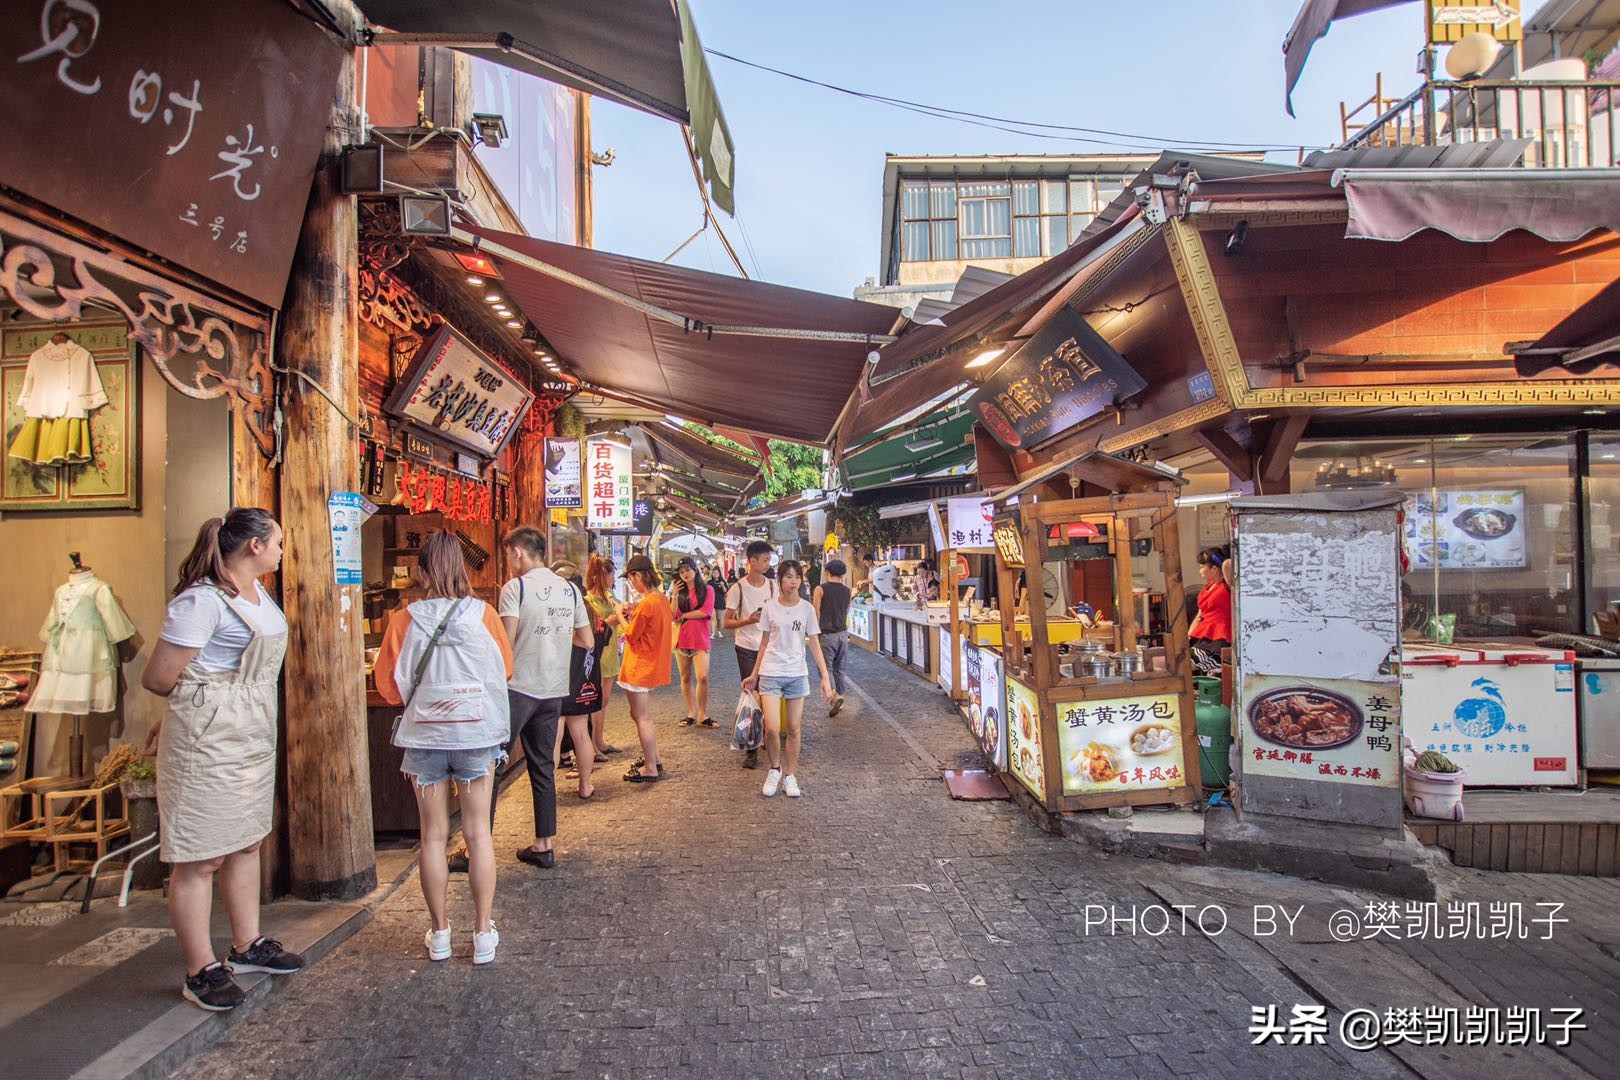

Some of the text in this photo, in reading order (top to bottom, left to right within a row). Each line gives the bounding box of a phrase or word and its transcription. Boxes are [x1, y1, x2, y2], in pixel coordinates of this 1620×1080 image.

[179, 203, 249, 254] 三号店
[592, 442, 615, 519] 百货超市
[618, 475, 630, 518] 厦门烟草
[1065, 701, 1174, 728] 蟹黄汤包
[1366, 695, 1392, 752] 姜母鸭
[1118, 765, 1181, 784] 百年风味
[1253, 747, 1313, 763] 宫廷御膳
